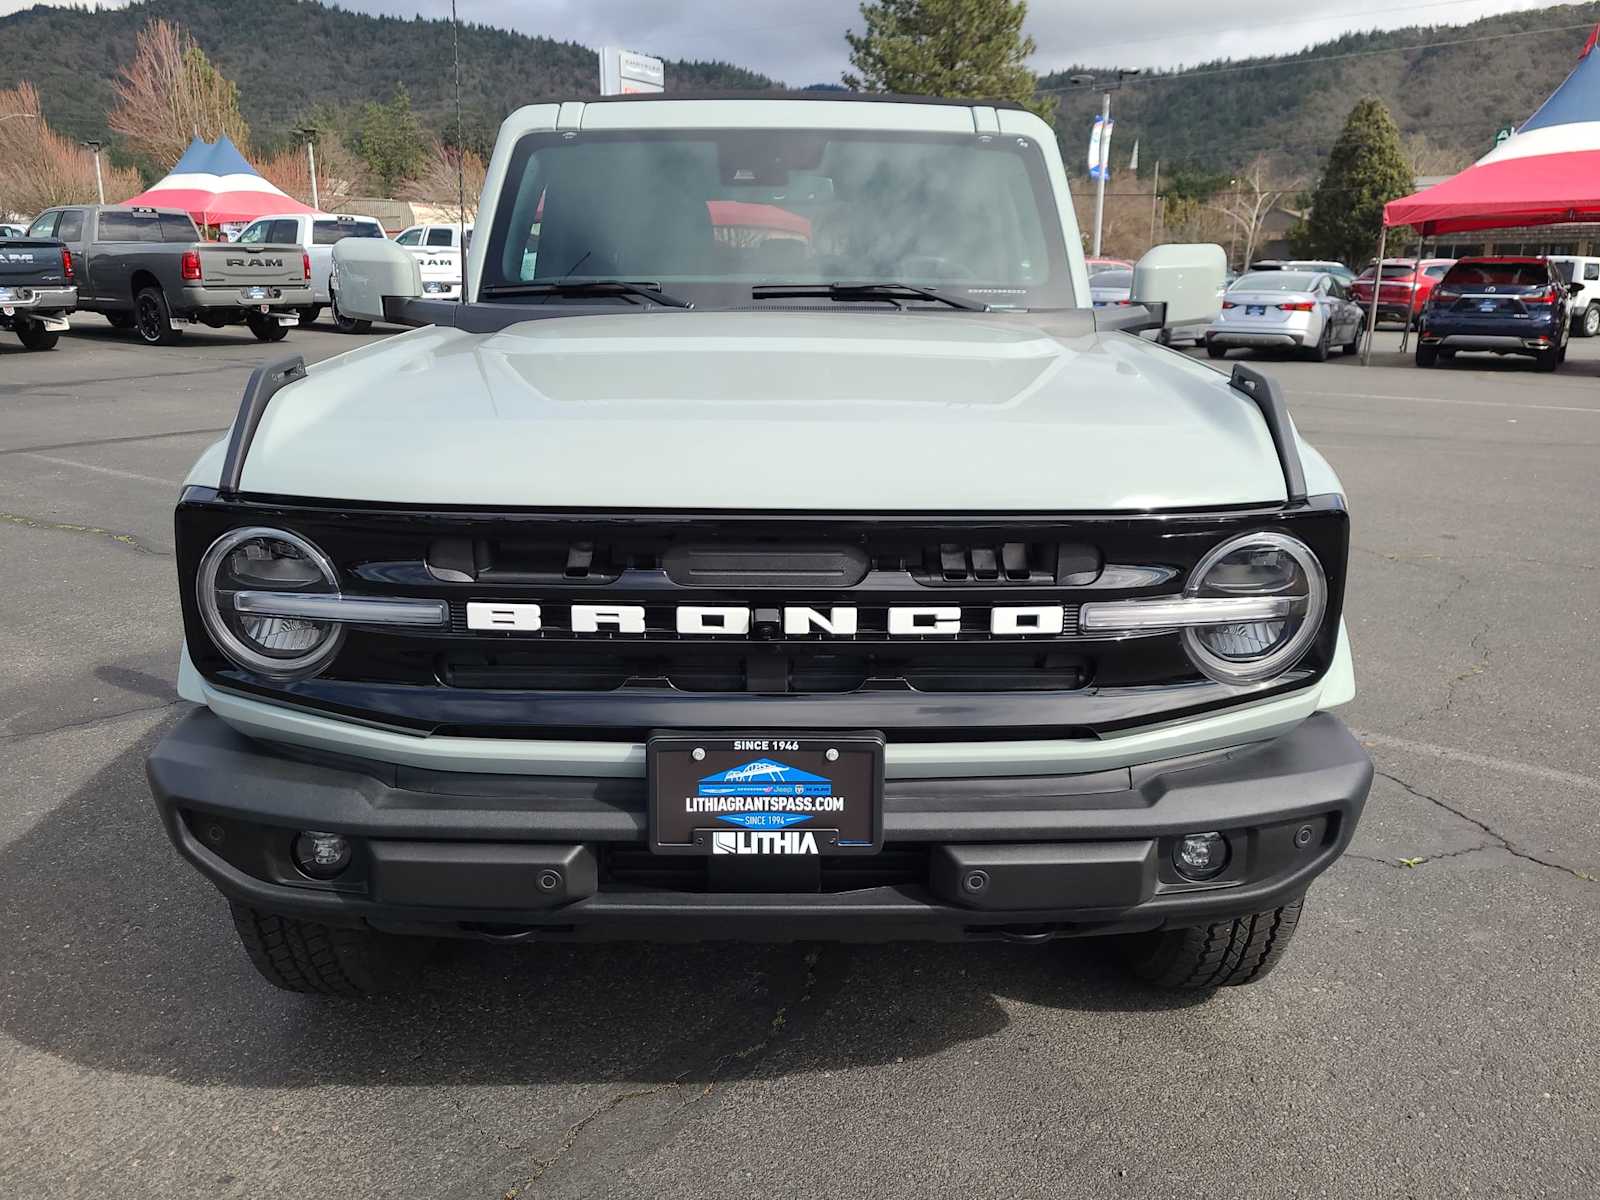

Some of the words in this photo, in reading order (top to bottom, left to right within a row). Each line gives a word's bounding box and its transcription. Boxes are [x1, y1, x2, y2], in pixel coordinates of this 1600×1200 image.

[226, 258, 283, 267] RAM
[466, 602, 1064, 636] BRONCO
[734, 741, 769, 750] SINCE
[772, 741, 799, 750] 1946
[686, 797, 844, 812] LITHIAGRANTSPASS.COM
[745, 816, 766, 826] SINCE
[768, 816, 785, 825] 1994
[737, 831, 819, 855] LITHIA
